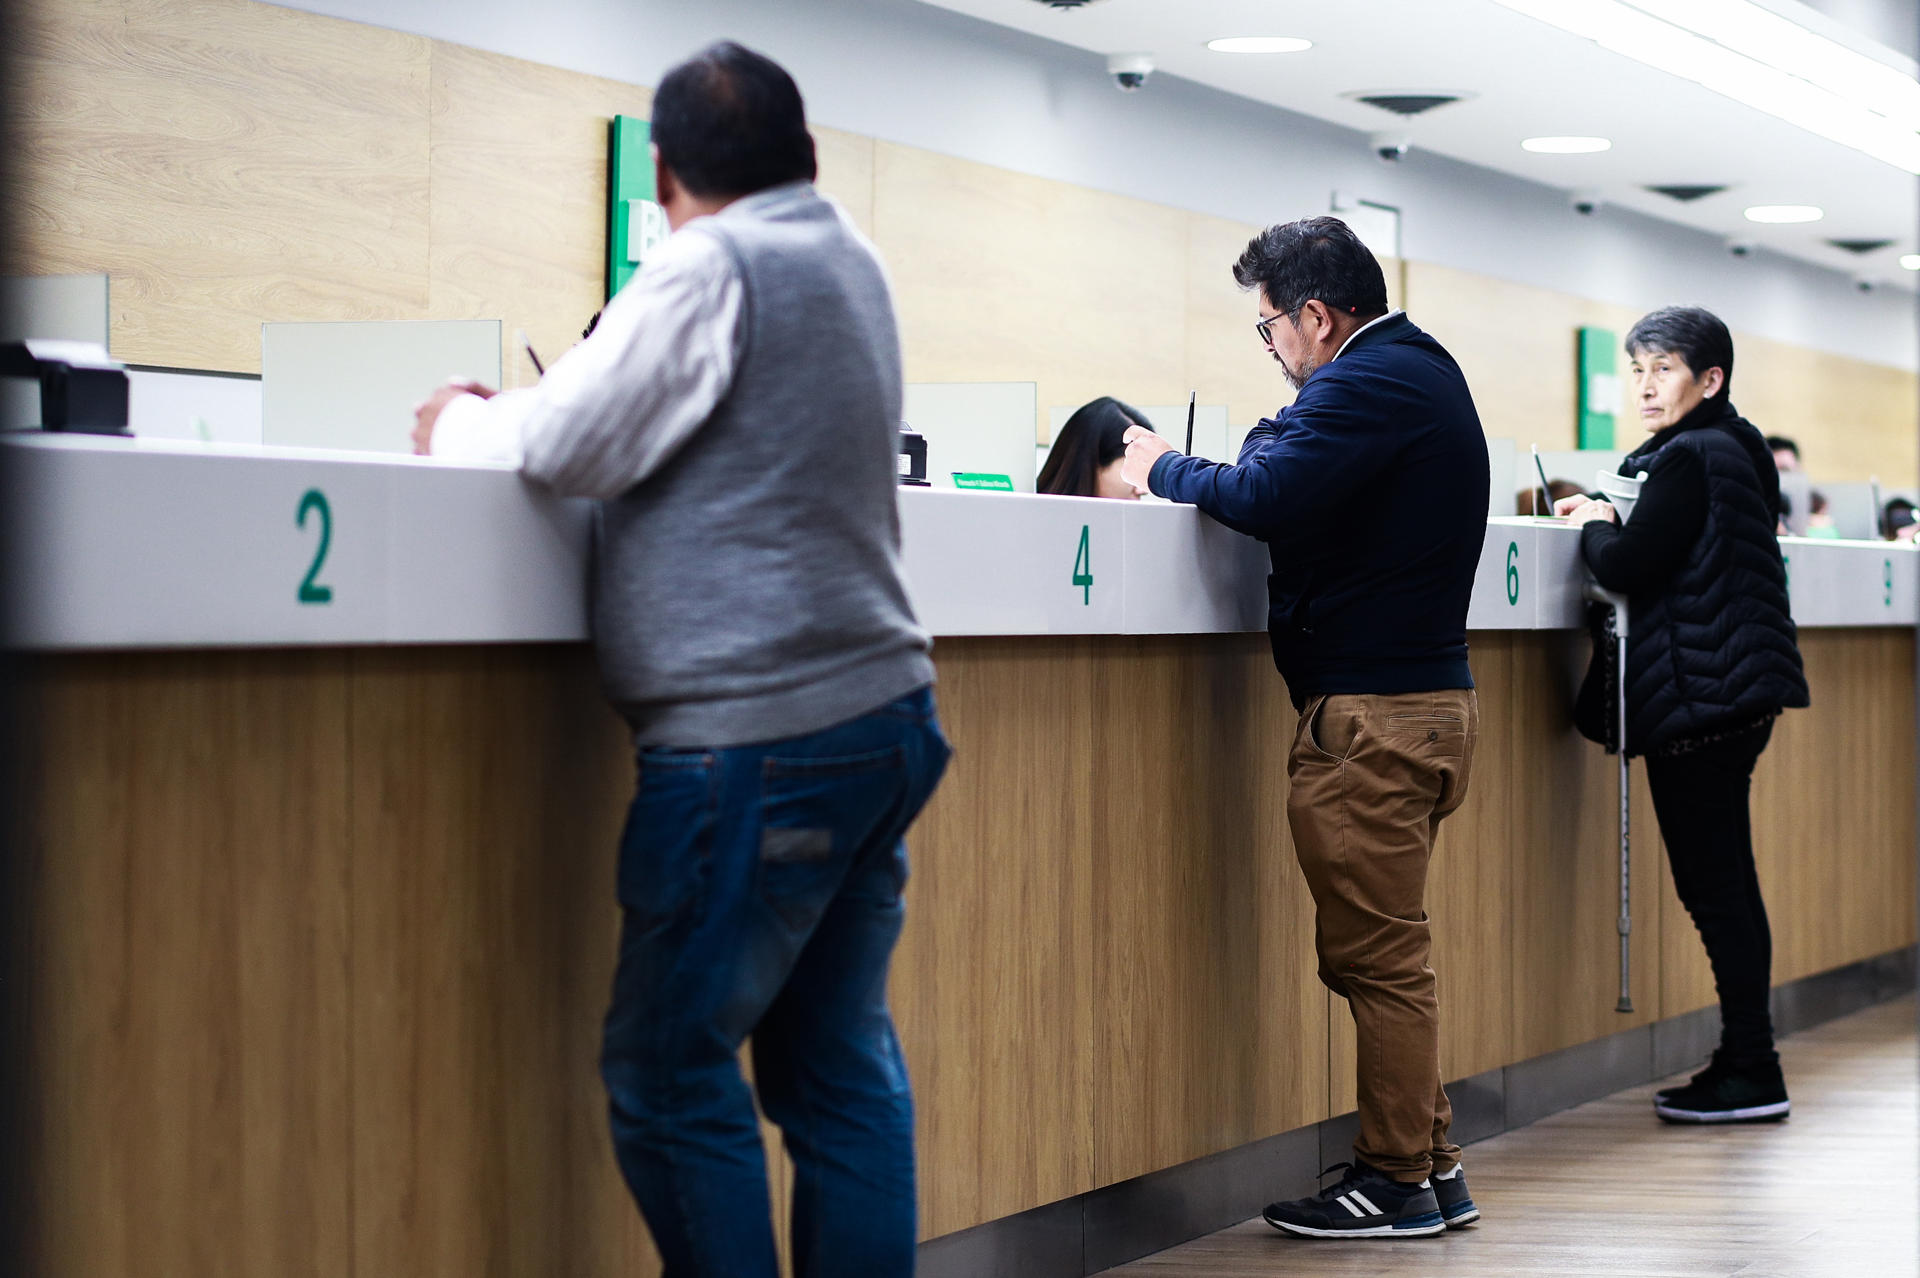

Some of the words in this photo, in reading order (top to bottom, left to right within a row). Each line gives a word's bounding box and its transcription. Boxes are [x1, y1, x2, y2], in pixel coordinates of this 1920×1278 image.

[296, 489, 332, 605] 2
[1072, 525, 1094, 605] 4
[1506, 541, 1519, 606] 6
